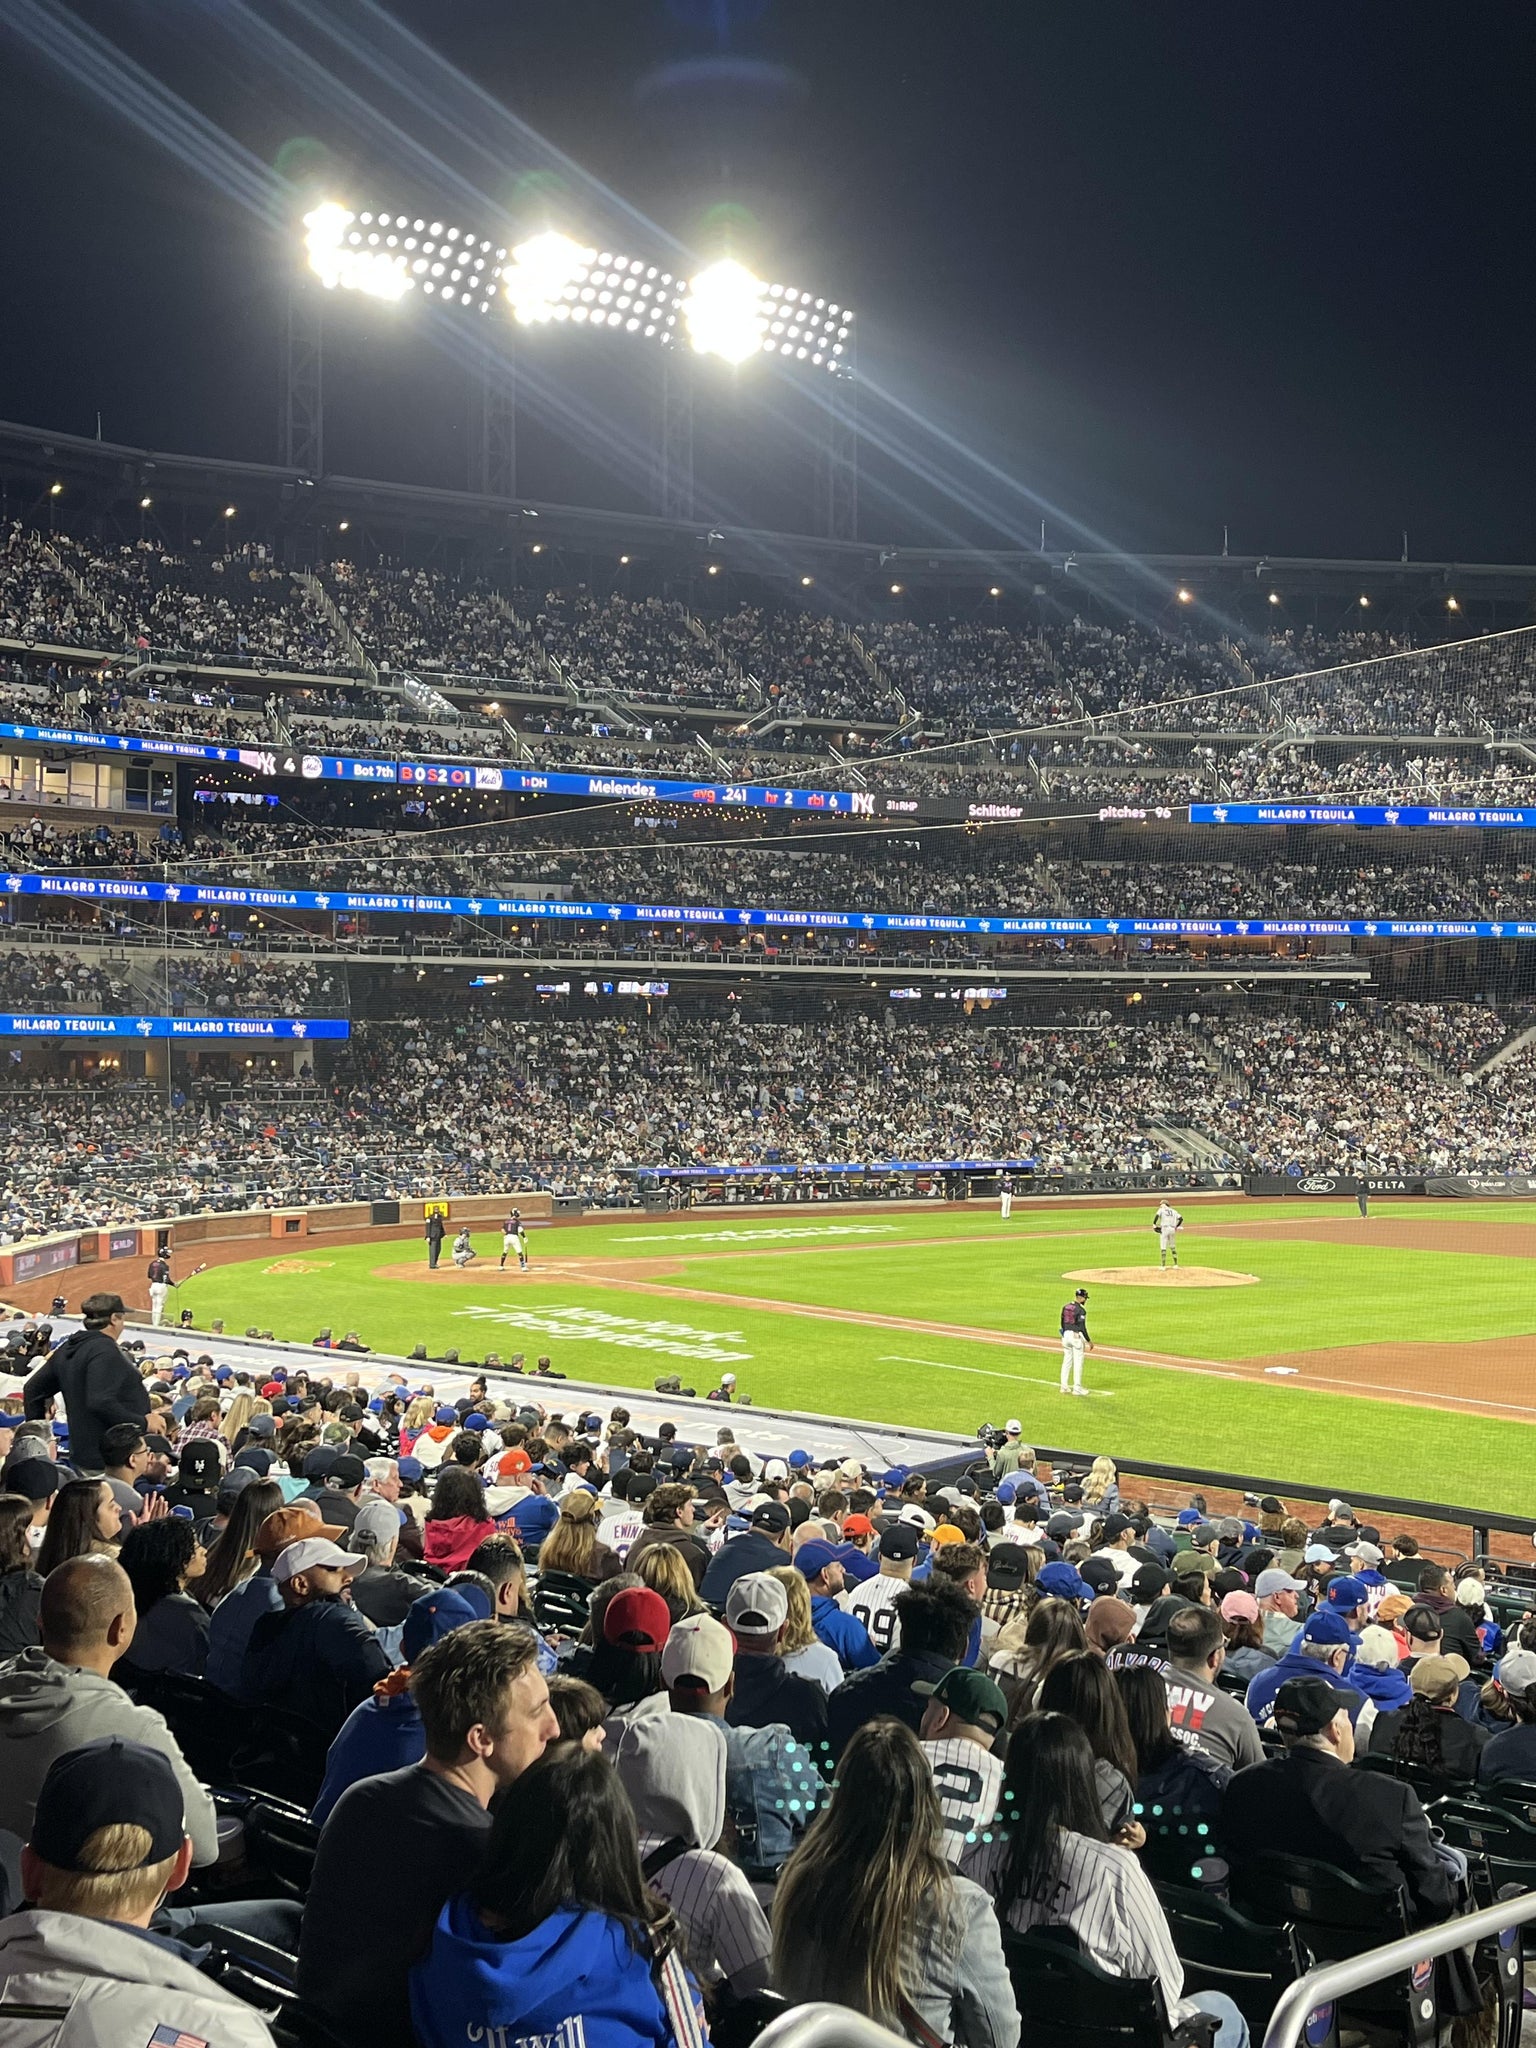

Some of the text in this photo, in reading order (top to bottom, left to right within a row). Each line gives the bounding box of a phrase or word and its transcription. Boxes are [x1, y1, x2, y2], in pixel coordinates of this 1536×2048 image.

[38, 731, 107, 744] MILAGRO TEQUILA
[142, 742, 206, 755] MILAGRO TEQUILA
[284, 758, 296, 772] 4
[336, 761, 343, 776] 1
[354, 764, 395, 778] Bot 7th
[589, 779, 657, 798] Melendez
[692, 788, 747, 804] avg .241
[765, 790, 794, 805] hr 2
[807, 793, 838, 807] rbi 6
[968, 803, 1023, 818] Schlittler
[1100, 806, 1172, 821] pitches 96
[1258, 810, 1355, 820] MILAGRO TEQUILA
[1429, 812, 1524, 822] MILAGRO TEQUILA
[41, 880, 148, 896] MILAGRO TEQUILA
[198, 889, 297, 904] MILAGRO TEQUILA
[348, 896, 452, 910] MILAGRO TEQUILA
[498, 903, 593, 915] MILAGRO TEQUILA
[636, 908, 724, 920] MILAGRO TEQUILA
[766, 913, 848, 925] MILAGRO TEQUILA
[888, 917, 966, 929] MILAGRO TEQUILA
[1003, 920, 1092, 931] MILAGRO TEQUILA
[1134, 921, 1221, 932] MILAGRO TEQUILA
[1263, 923, 1350, 933] MILAGRO TEQUILA
[1392, 923, 1477, 934] MILAGRO TEQUILA
[13, 1019, 116, 1032] MILAGRO TEQUILA
[172, 1021, 274, 1034] MILAGRO TEQUILA
[1303, 1180, 1329, 1191] Ford
[1368, 1181, 1406, 1189] DELTA
